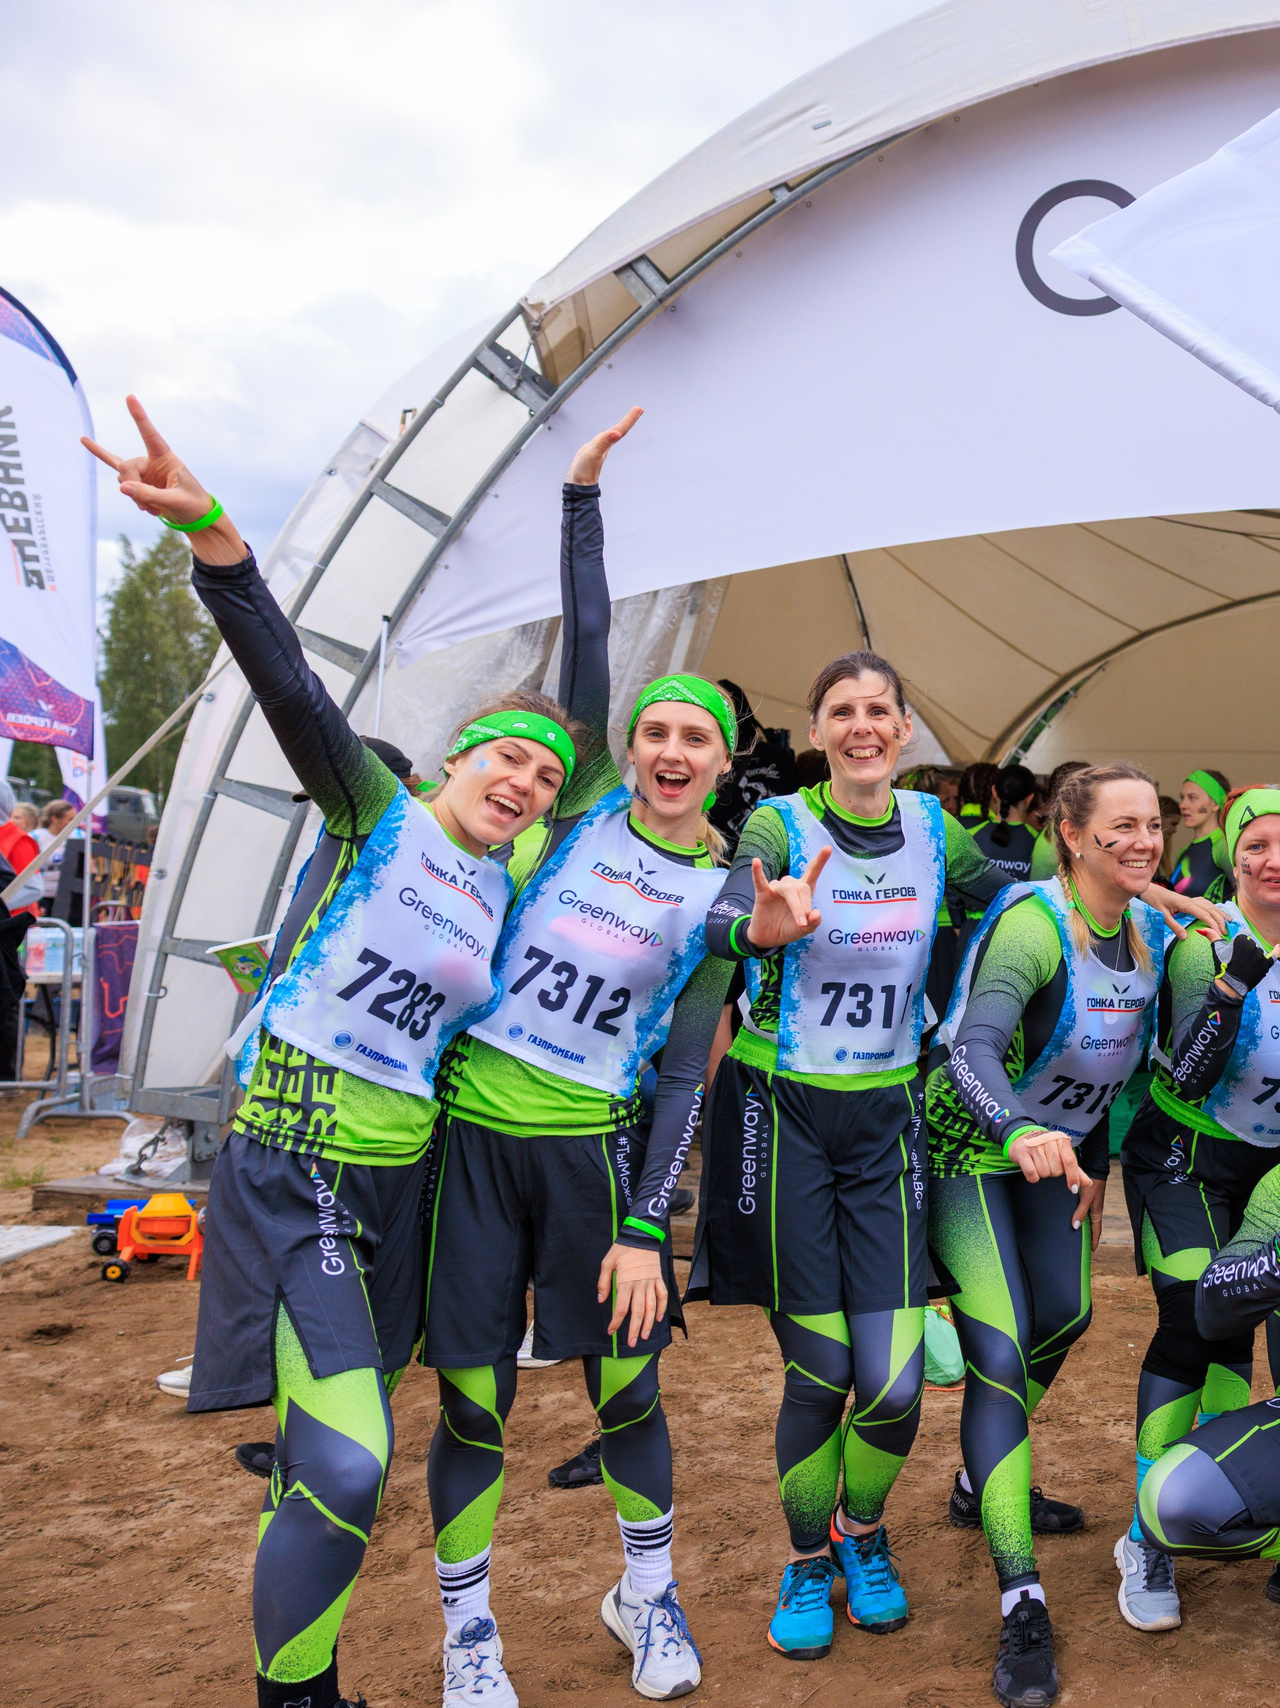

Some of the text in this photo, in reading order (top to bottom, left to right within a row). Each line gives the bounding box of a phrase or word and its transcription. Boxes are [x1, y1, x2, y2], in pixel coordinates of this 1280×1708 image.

[420, 851, 458, 886] ГОНКА
[593, 862, 685, 904] ГОНКА ГЕРОЕВ
[832, 886, 917, 901] ГОНКА ГЕРОЕВ
[398, 887, 484, 957] Greenway
[558, 889, 655, 946] Greenway
[581, 918, 627, 943] GLOBAL
[828, 928, 916, 946] Greenway
[424, 924, 463, 953] GLOBAL
[336, 947, 446, 1041] 7283
[508, 945, 631, 1037] 7312
[1086, 996, 1145, 1009] ГОНКА ГЕРОЕВ
[528, 1033, 586, 1065] ГАЗПРОМБАНК
[1173, 1020, 1218, 1084] eenway
[1191, 1047, 1216, 1084] GLOBAL
[950, 1045, 1001, 1119] Greenwa
[738, 1097, 764, 1215] Greenway
[761, 1123, 769, 1178] GLOBAL
[1222, 1282, 1267, 1297] GLOBAL
